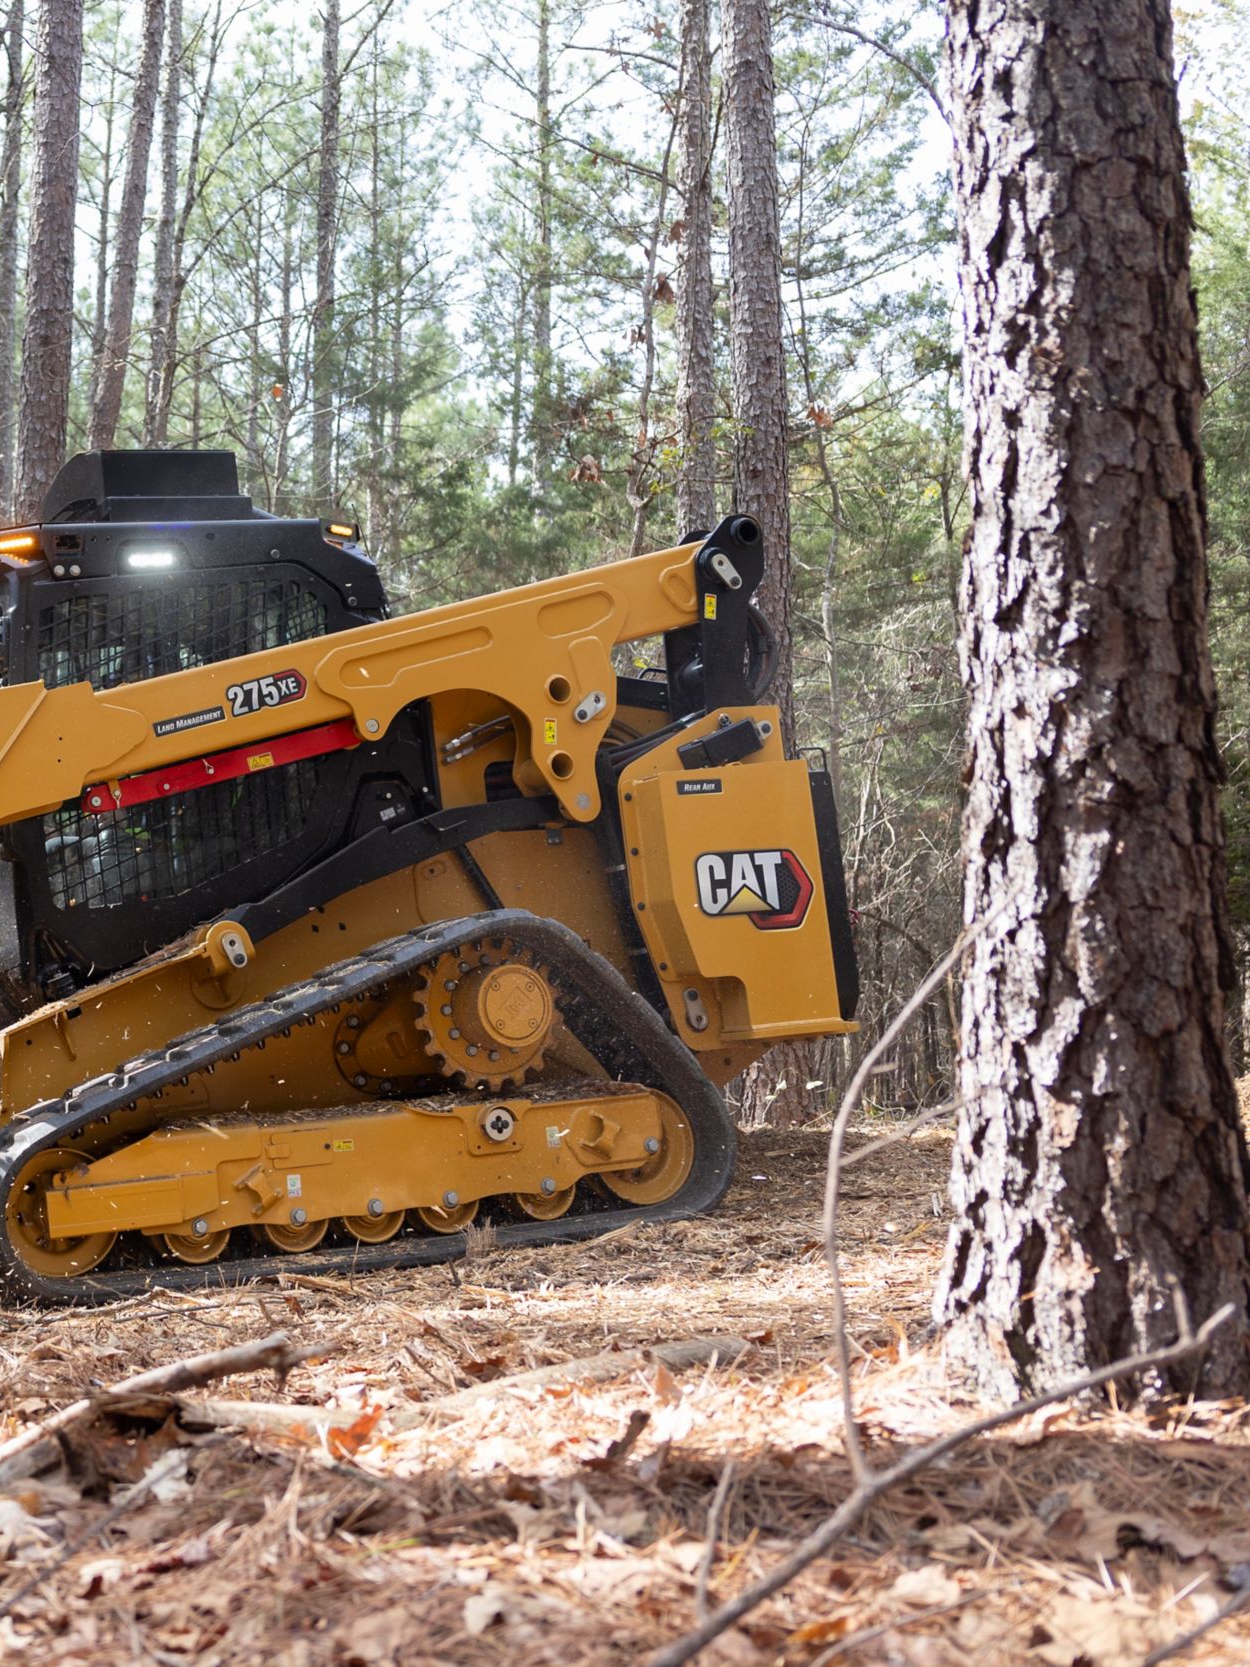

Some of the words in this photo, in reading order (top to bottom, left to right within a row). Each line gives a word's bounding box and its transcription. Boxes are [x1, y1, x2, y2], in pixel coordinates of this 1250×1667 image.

[157, 722, 175, 734] LAND
[176, 710, 222, 729] MANAGEMENT
[684, 784, 701, 792] REAR
[696, 851, 782, 915] CAT
